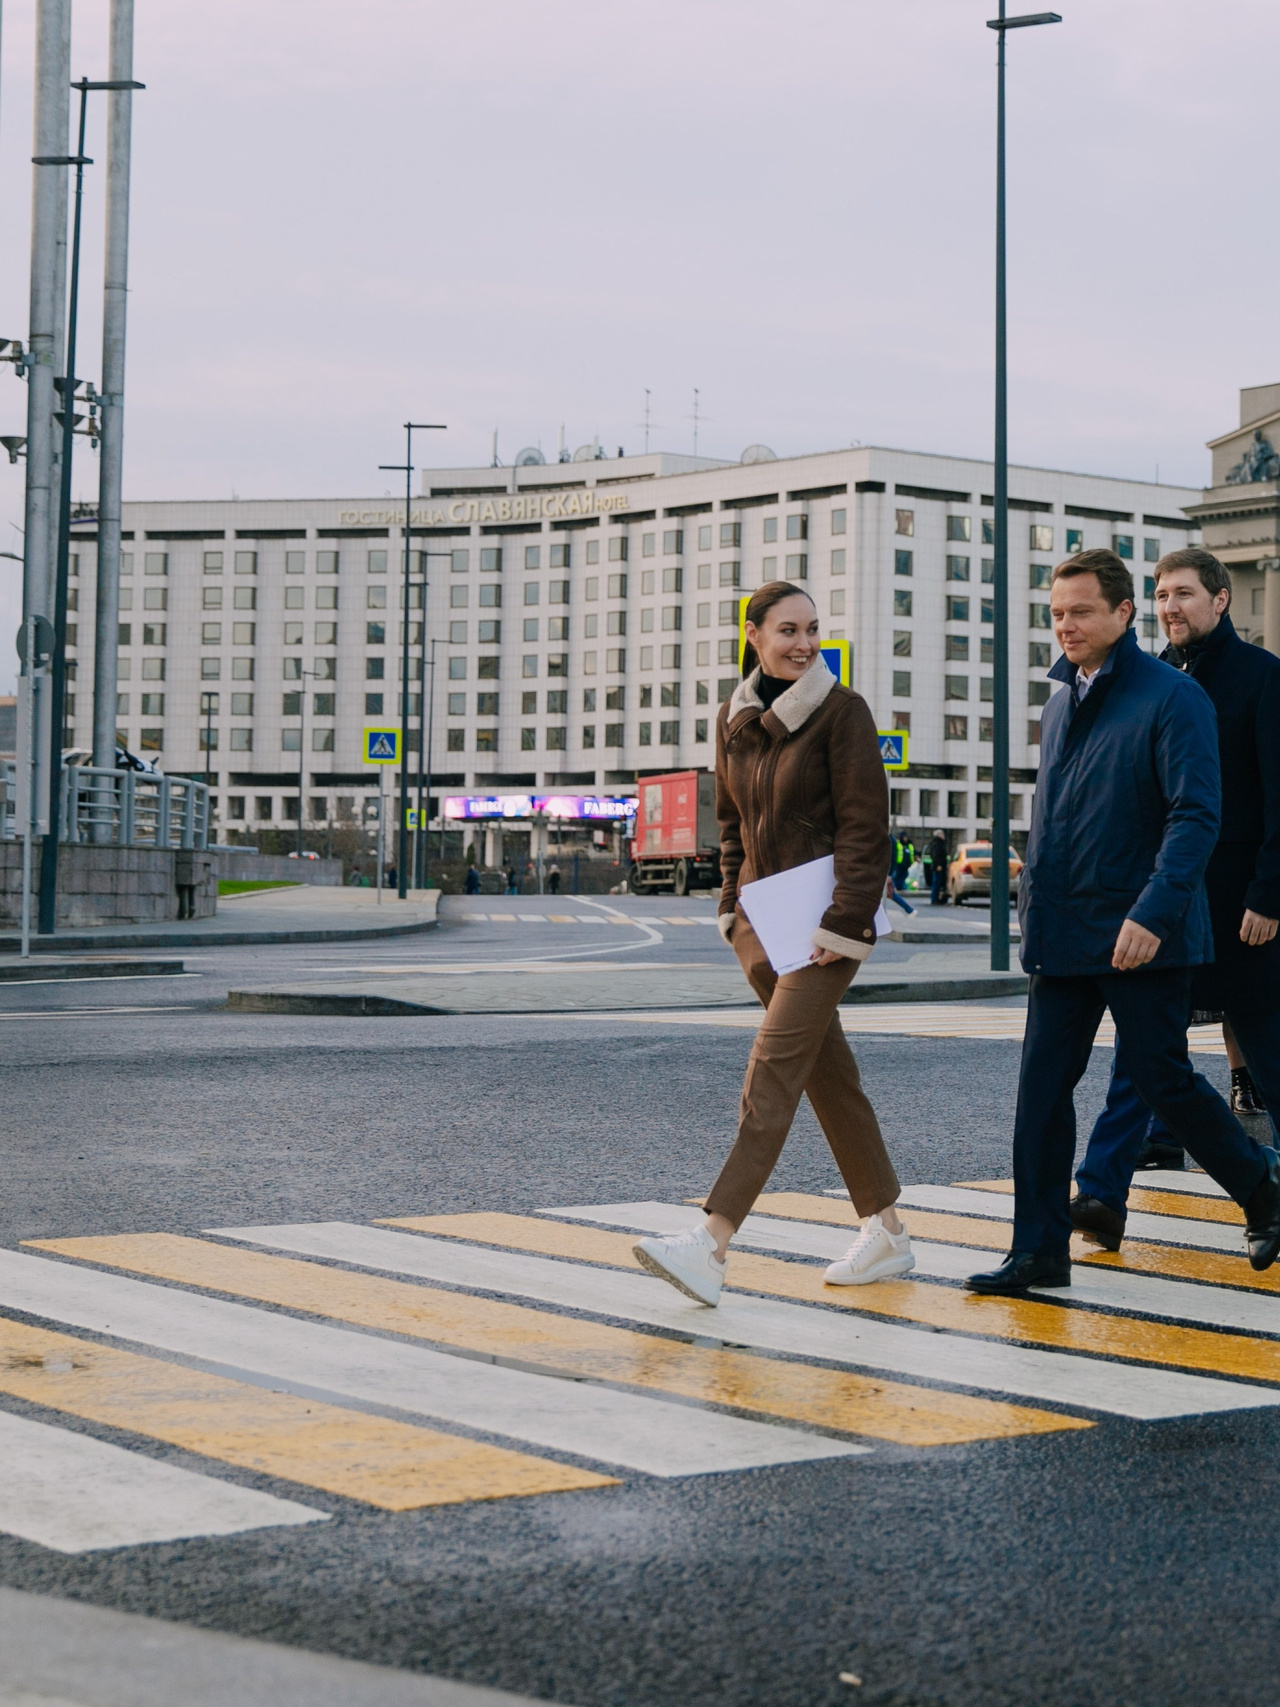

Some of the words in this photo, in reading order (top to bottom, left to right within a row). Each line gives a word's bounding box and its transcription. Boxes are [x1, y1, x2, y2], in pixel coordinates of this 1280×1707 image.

[338, 509, 445, 526] ГОСТИНИЦА
[448, 492, 595, 523] СЛАВЯНСКАЯ
[597, 495, 630, 512] HOTEL
